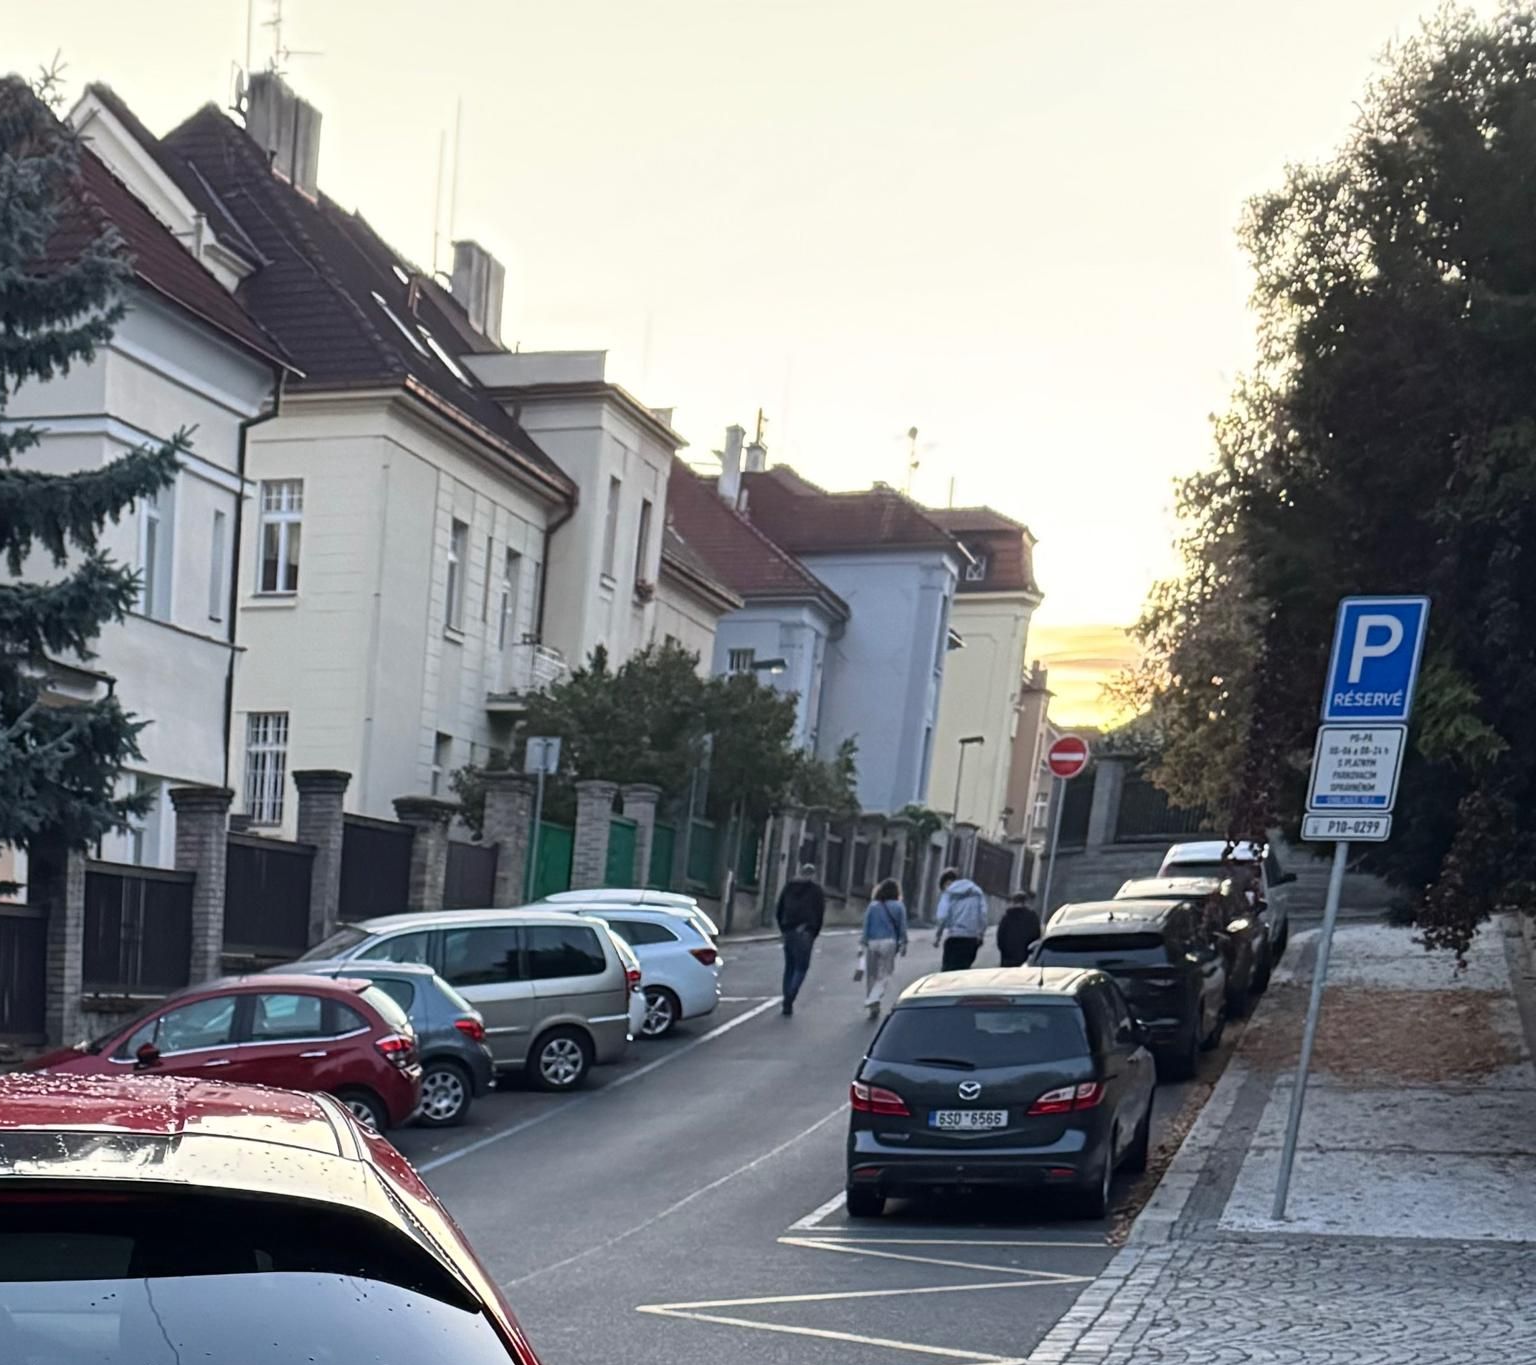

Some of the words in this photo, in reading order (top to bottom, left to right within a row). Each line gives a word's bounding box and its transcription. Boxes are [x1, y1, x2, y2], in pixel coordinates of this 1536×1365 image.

[1348, 614, 1404, 684] P
[1334, 689, 1403, 707] RÉSERVÉ
[1328, 820, 1380, 833] P10-0299
